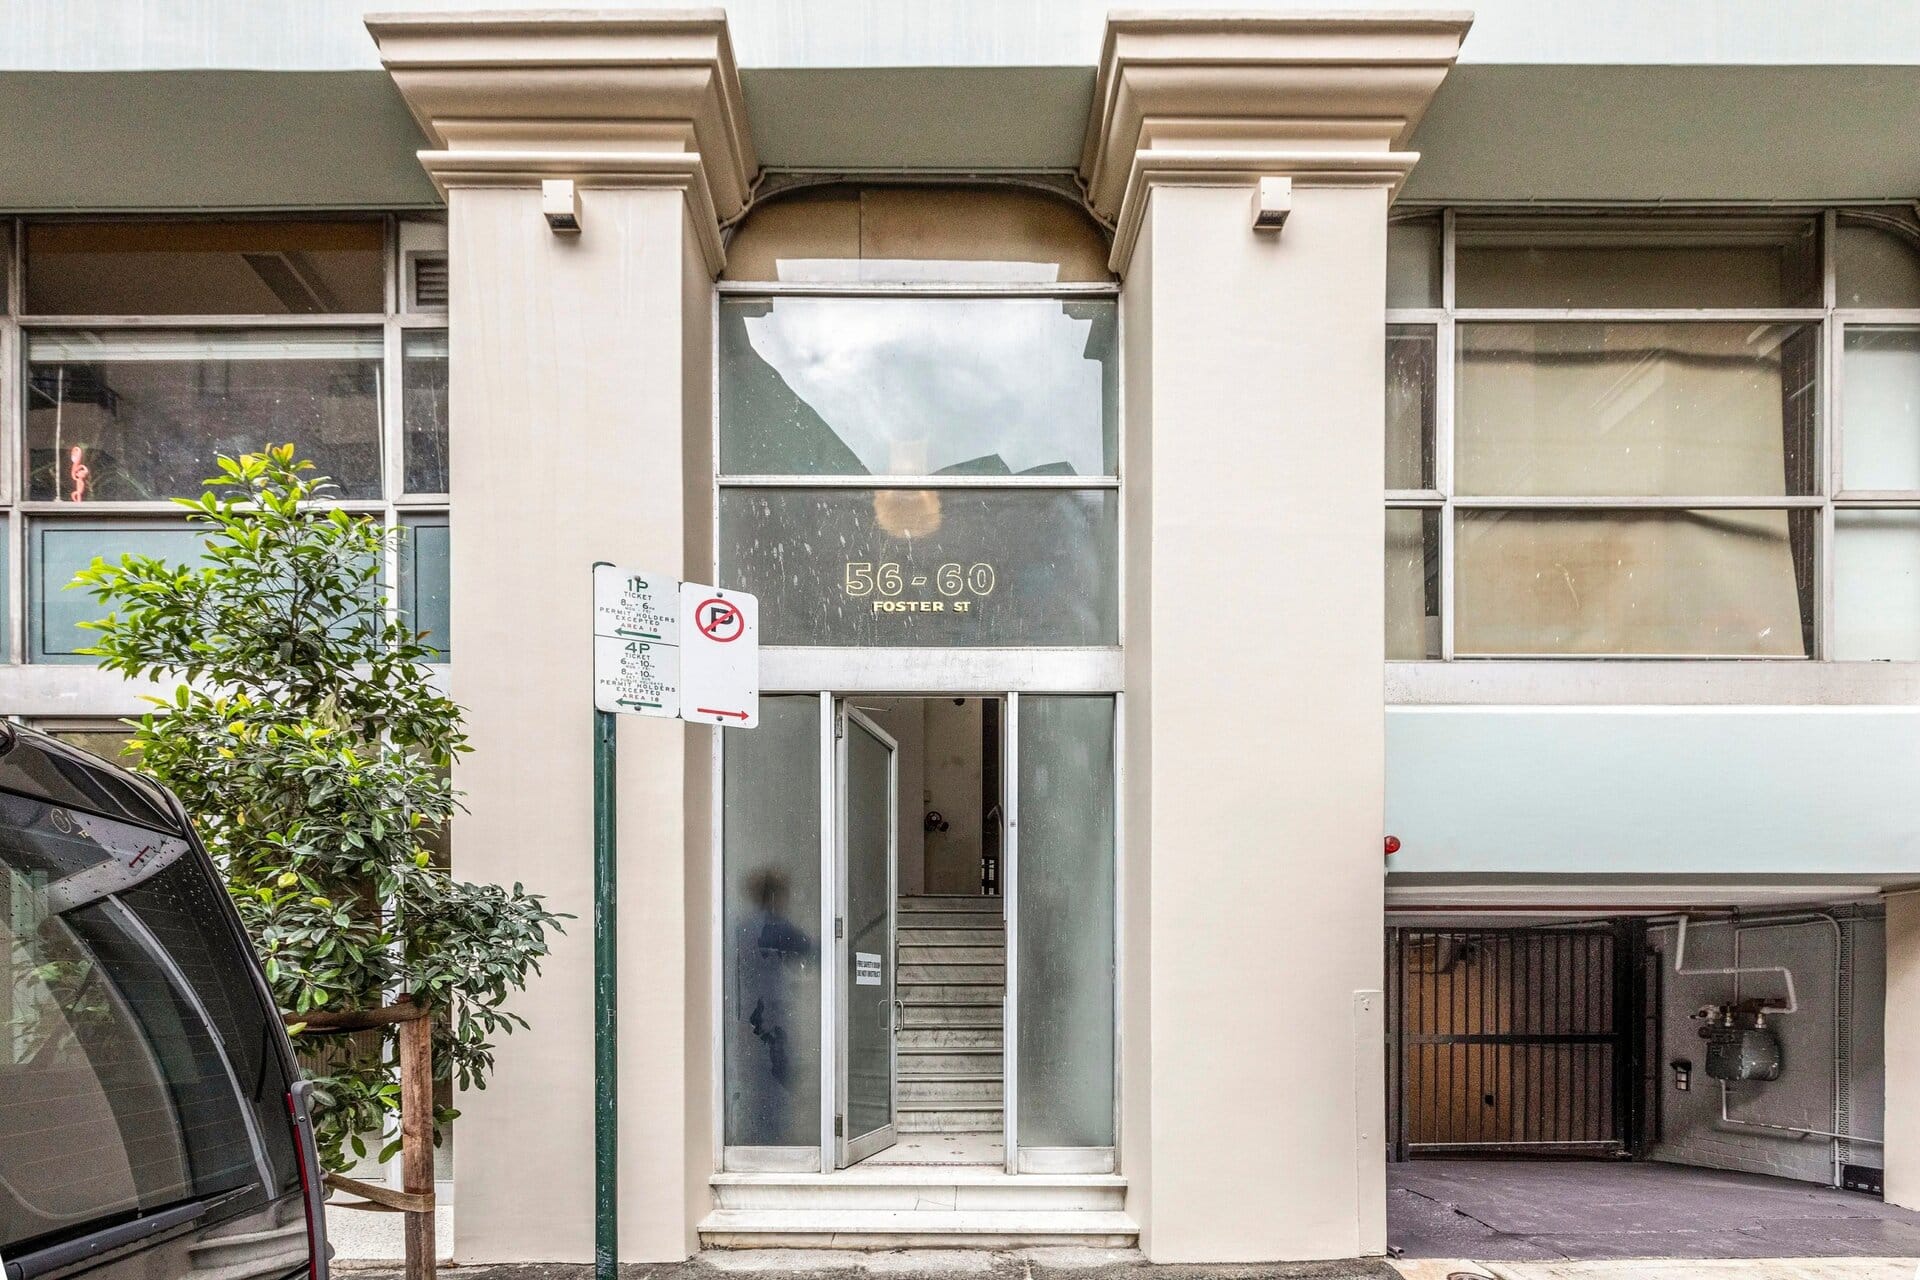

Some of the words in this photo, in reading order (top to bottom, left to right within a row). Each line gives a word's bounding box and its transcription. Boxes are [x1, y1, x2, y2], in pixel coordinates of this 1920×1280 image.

[627, 579, 649, 593] 1P
[624, 591, 652, 600] TICKET
[873, 601, 944, 612] FOSTER
[600, 607, 631, 616] PERMIT
[636, 613, 675, 623] HOLDERS
[615, 615, 660, 626] EXCEPTED
[624, 642, 650, 654] 4P
[600, 679, 631, 687] PERMIT
[637, 684, 676, 692] HOLDERS
[616, 687, 660, 696] EXCEPTED
